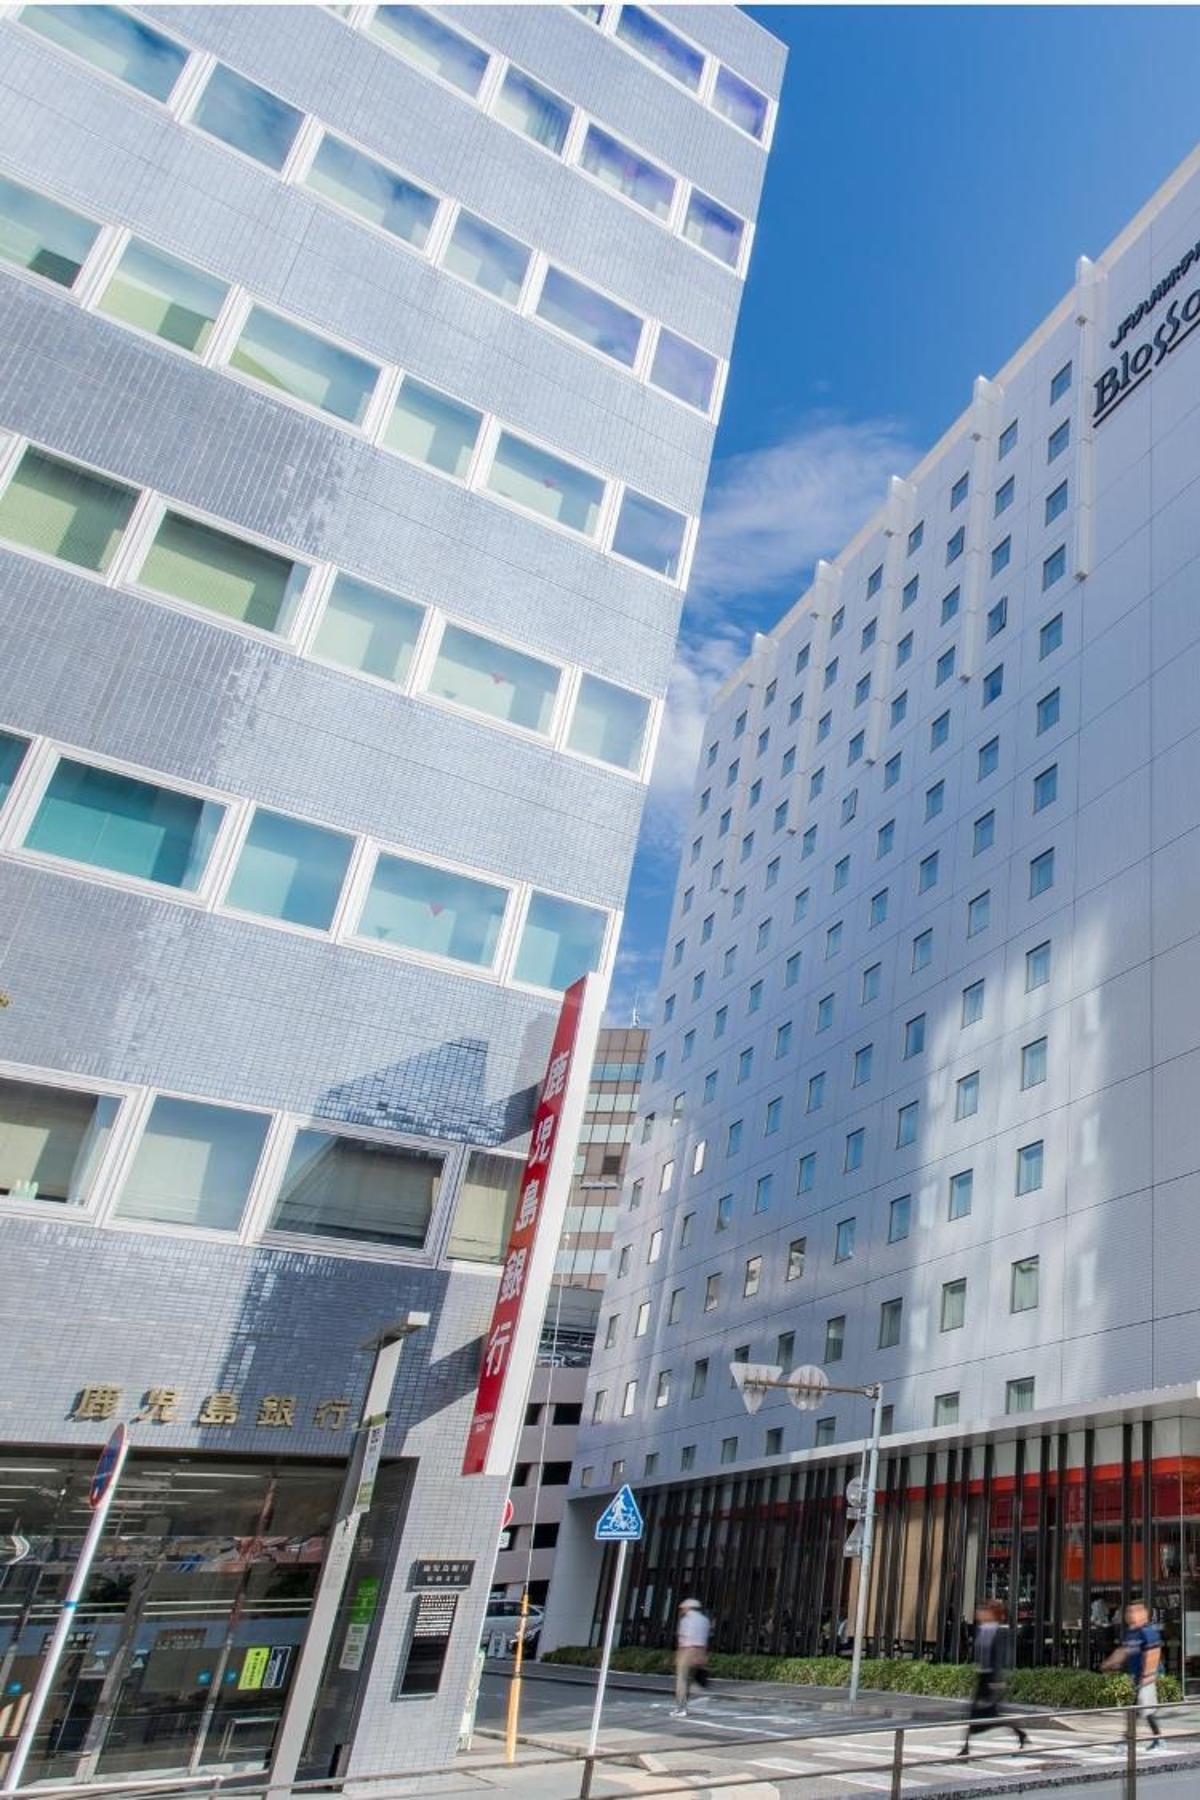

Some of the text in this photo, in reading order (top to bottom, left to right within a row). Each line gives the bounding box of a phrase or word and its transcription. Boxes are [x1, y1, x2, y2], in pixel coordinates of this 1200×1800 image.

[486, 1051, 569, 1378] 鹿児島銀行
[75, 1385, 350, 1430] 鹿児島銀行
